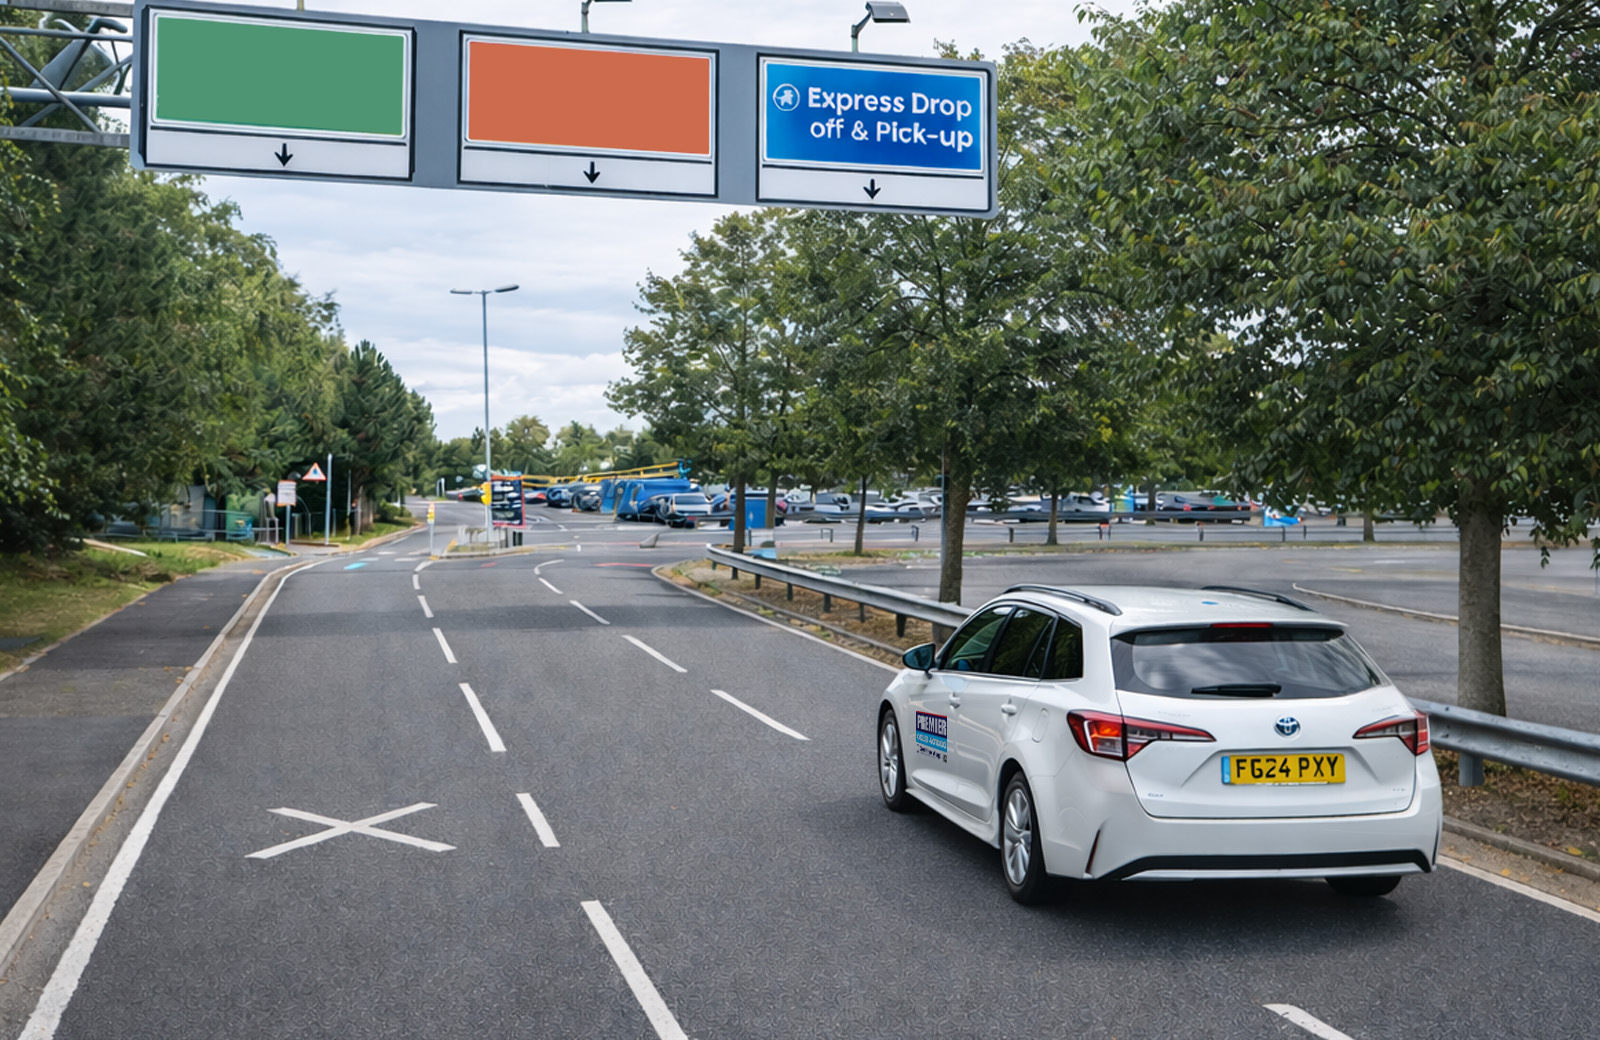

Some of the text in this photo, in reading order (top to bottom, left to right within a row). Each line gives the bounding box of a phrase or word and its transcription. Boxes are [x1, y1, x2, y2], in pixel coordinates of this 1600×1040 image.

[808, 86, 972, 121] Express Drop
[810, 118, 973, 152] off & Pick-up
[1235, 755, 1338, 778] FG24 PXY
